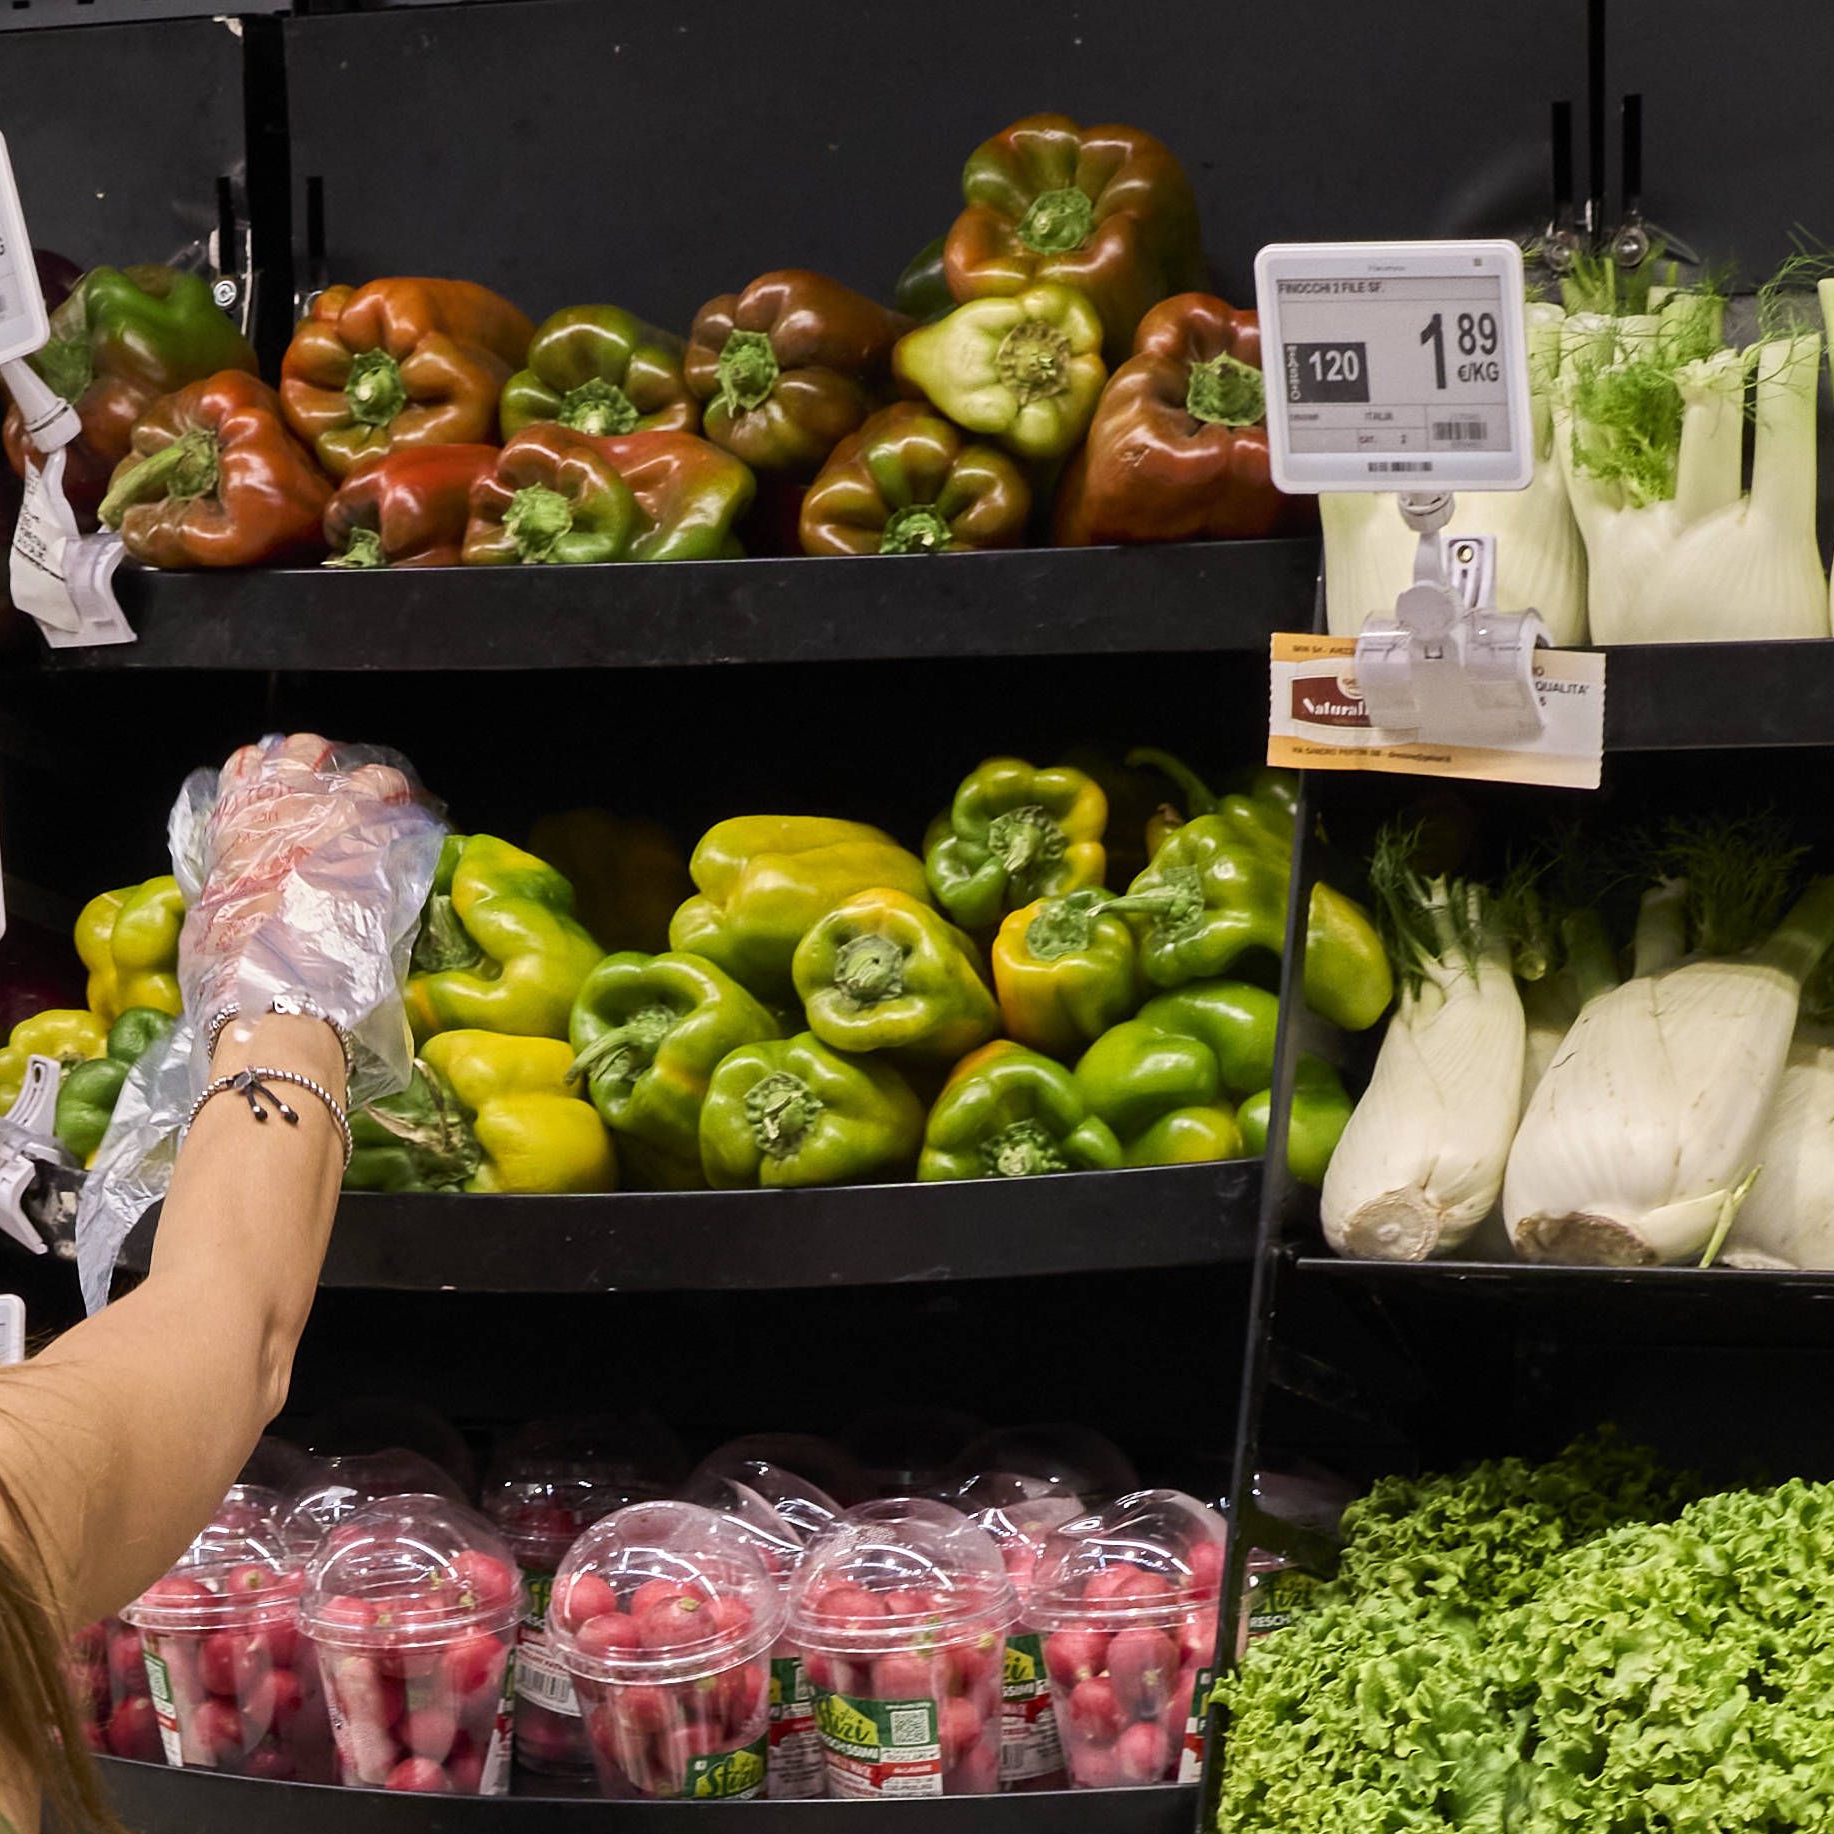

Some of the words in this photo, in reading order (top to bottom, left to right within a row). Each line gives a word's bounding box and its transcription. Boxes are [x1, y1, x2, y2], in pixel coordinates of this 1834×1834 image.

[1277, 281, 1332, 295] FINOCCHI
[1341, 280, 1365, 294] FILE
[1420, 312, 1447, 390] 1
[1457, 303, 1498, 356] 89
[1309, 350, 1360, 382] 120
[1457, 362, 1500, 383] €/KG
